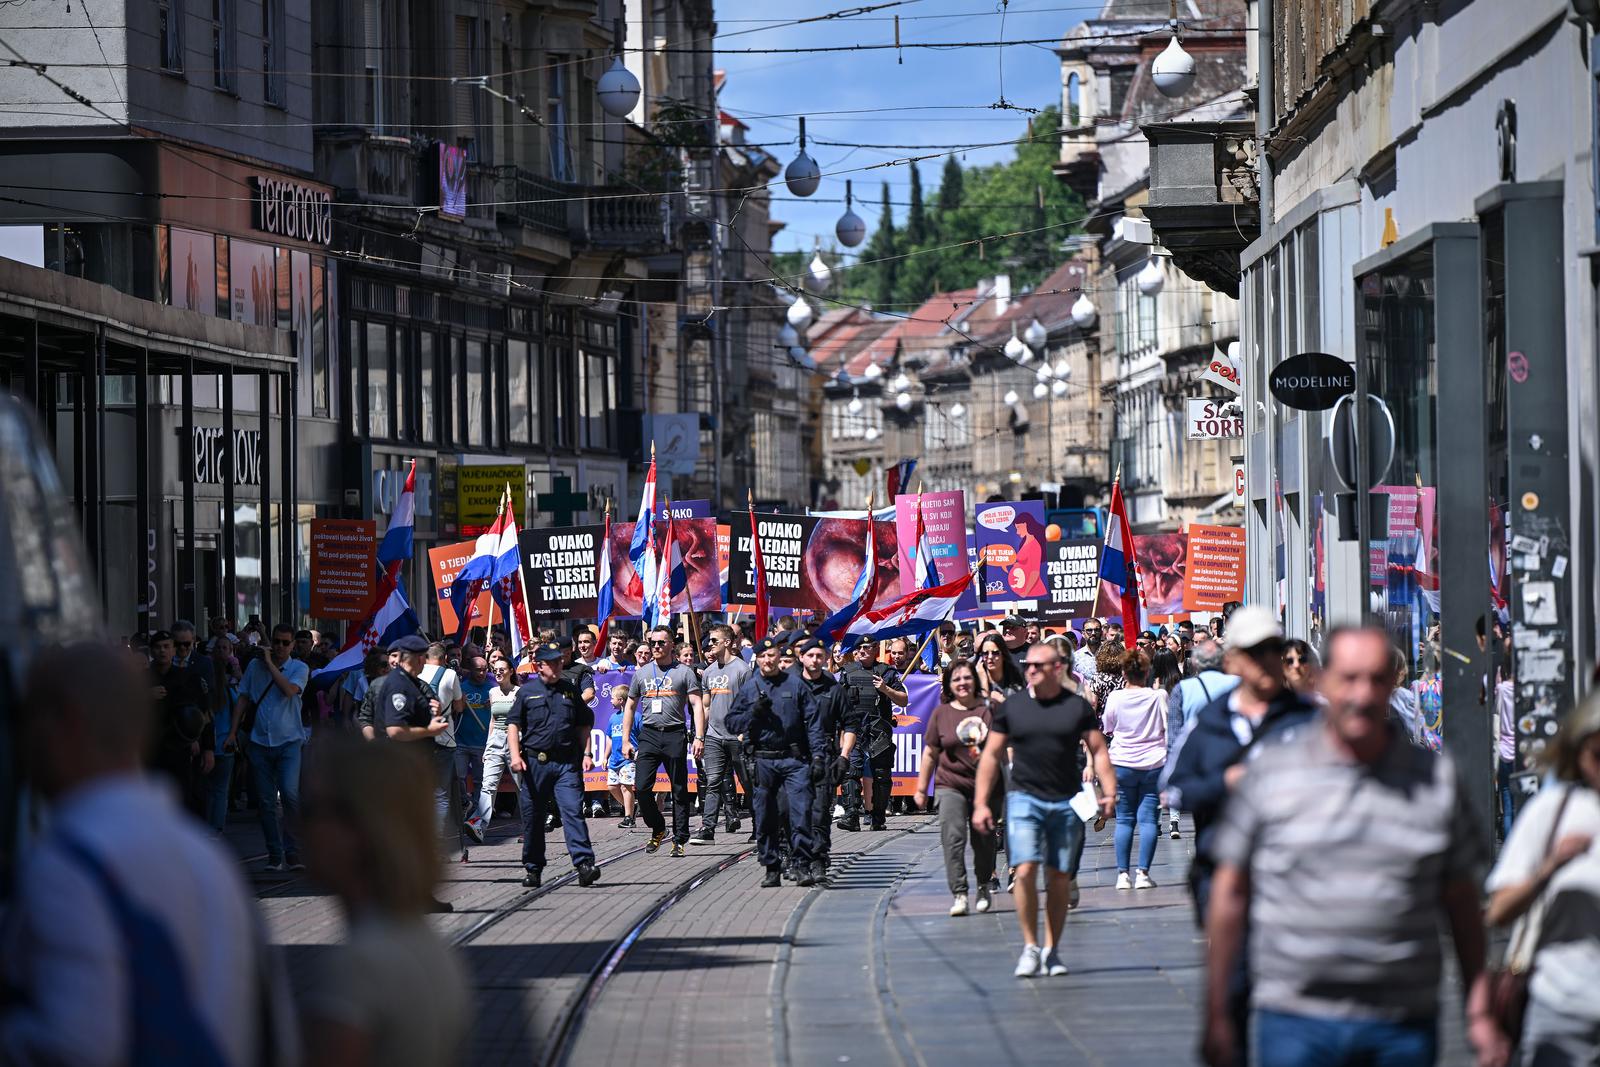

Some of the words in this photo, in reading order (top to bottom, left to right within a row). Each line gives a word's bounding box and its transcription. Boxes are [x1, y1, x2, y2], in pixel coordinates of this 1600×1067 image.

[1276, 376, 1351, 388] MODELINE
[462, 484, 494, 492] OTKUP
[468, 497, 517, 505] EXCHAE
[758, 521, 802, 538] OVAKO
[548, 534, 594, 551] OVAKO
[530, 550, 595, 568] IZGLEDAM
[1059, 544, 1097, 560] OVAKO
[440, 560, 446, 570] 9
[763, 555, 801, 572] DESET
[1047, 558, 1098, 575] ZGLEDAM
[442, 573, 454, 584] OD
[544, 569, 554, 584] S
[556, 566, 596, 584] DESET
[745, 570, 800, 588] TDANA
[1054, 575, 1062, 588] S
[1064, 574, 1098, 588] DESET
[540, 584, 598, 601] TJEDANA
[1051, 587, 1097, 603] TJEDANA
